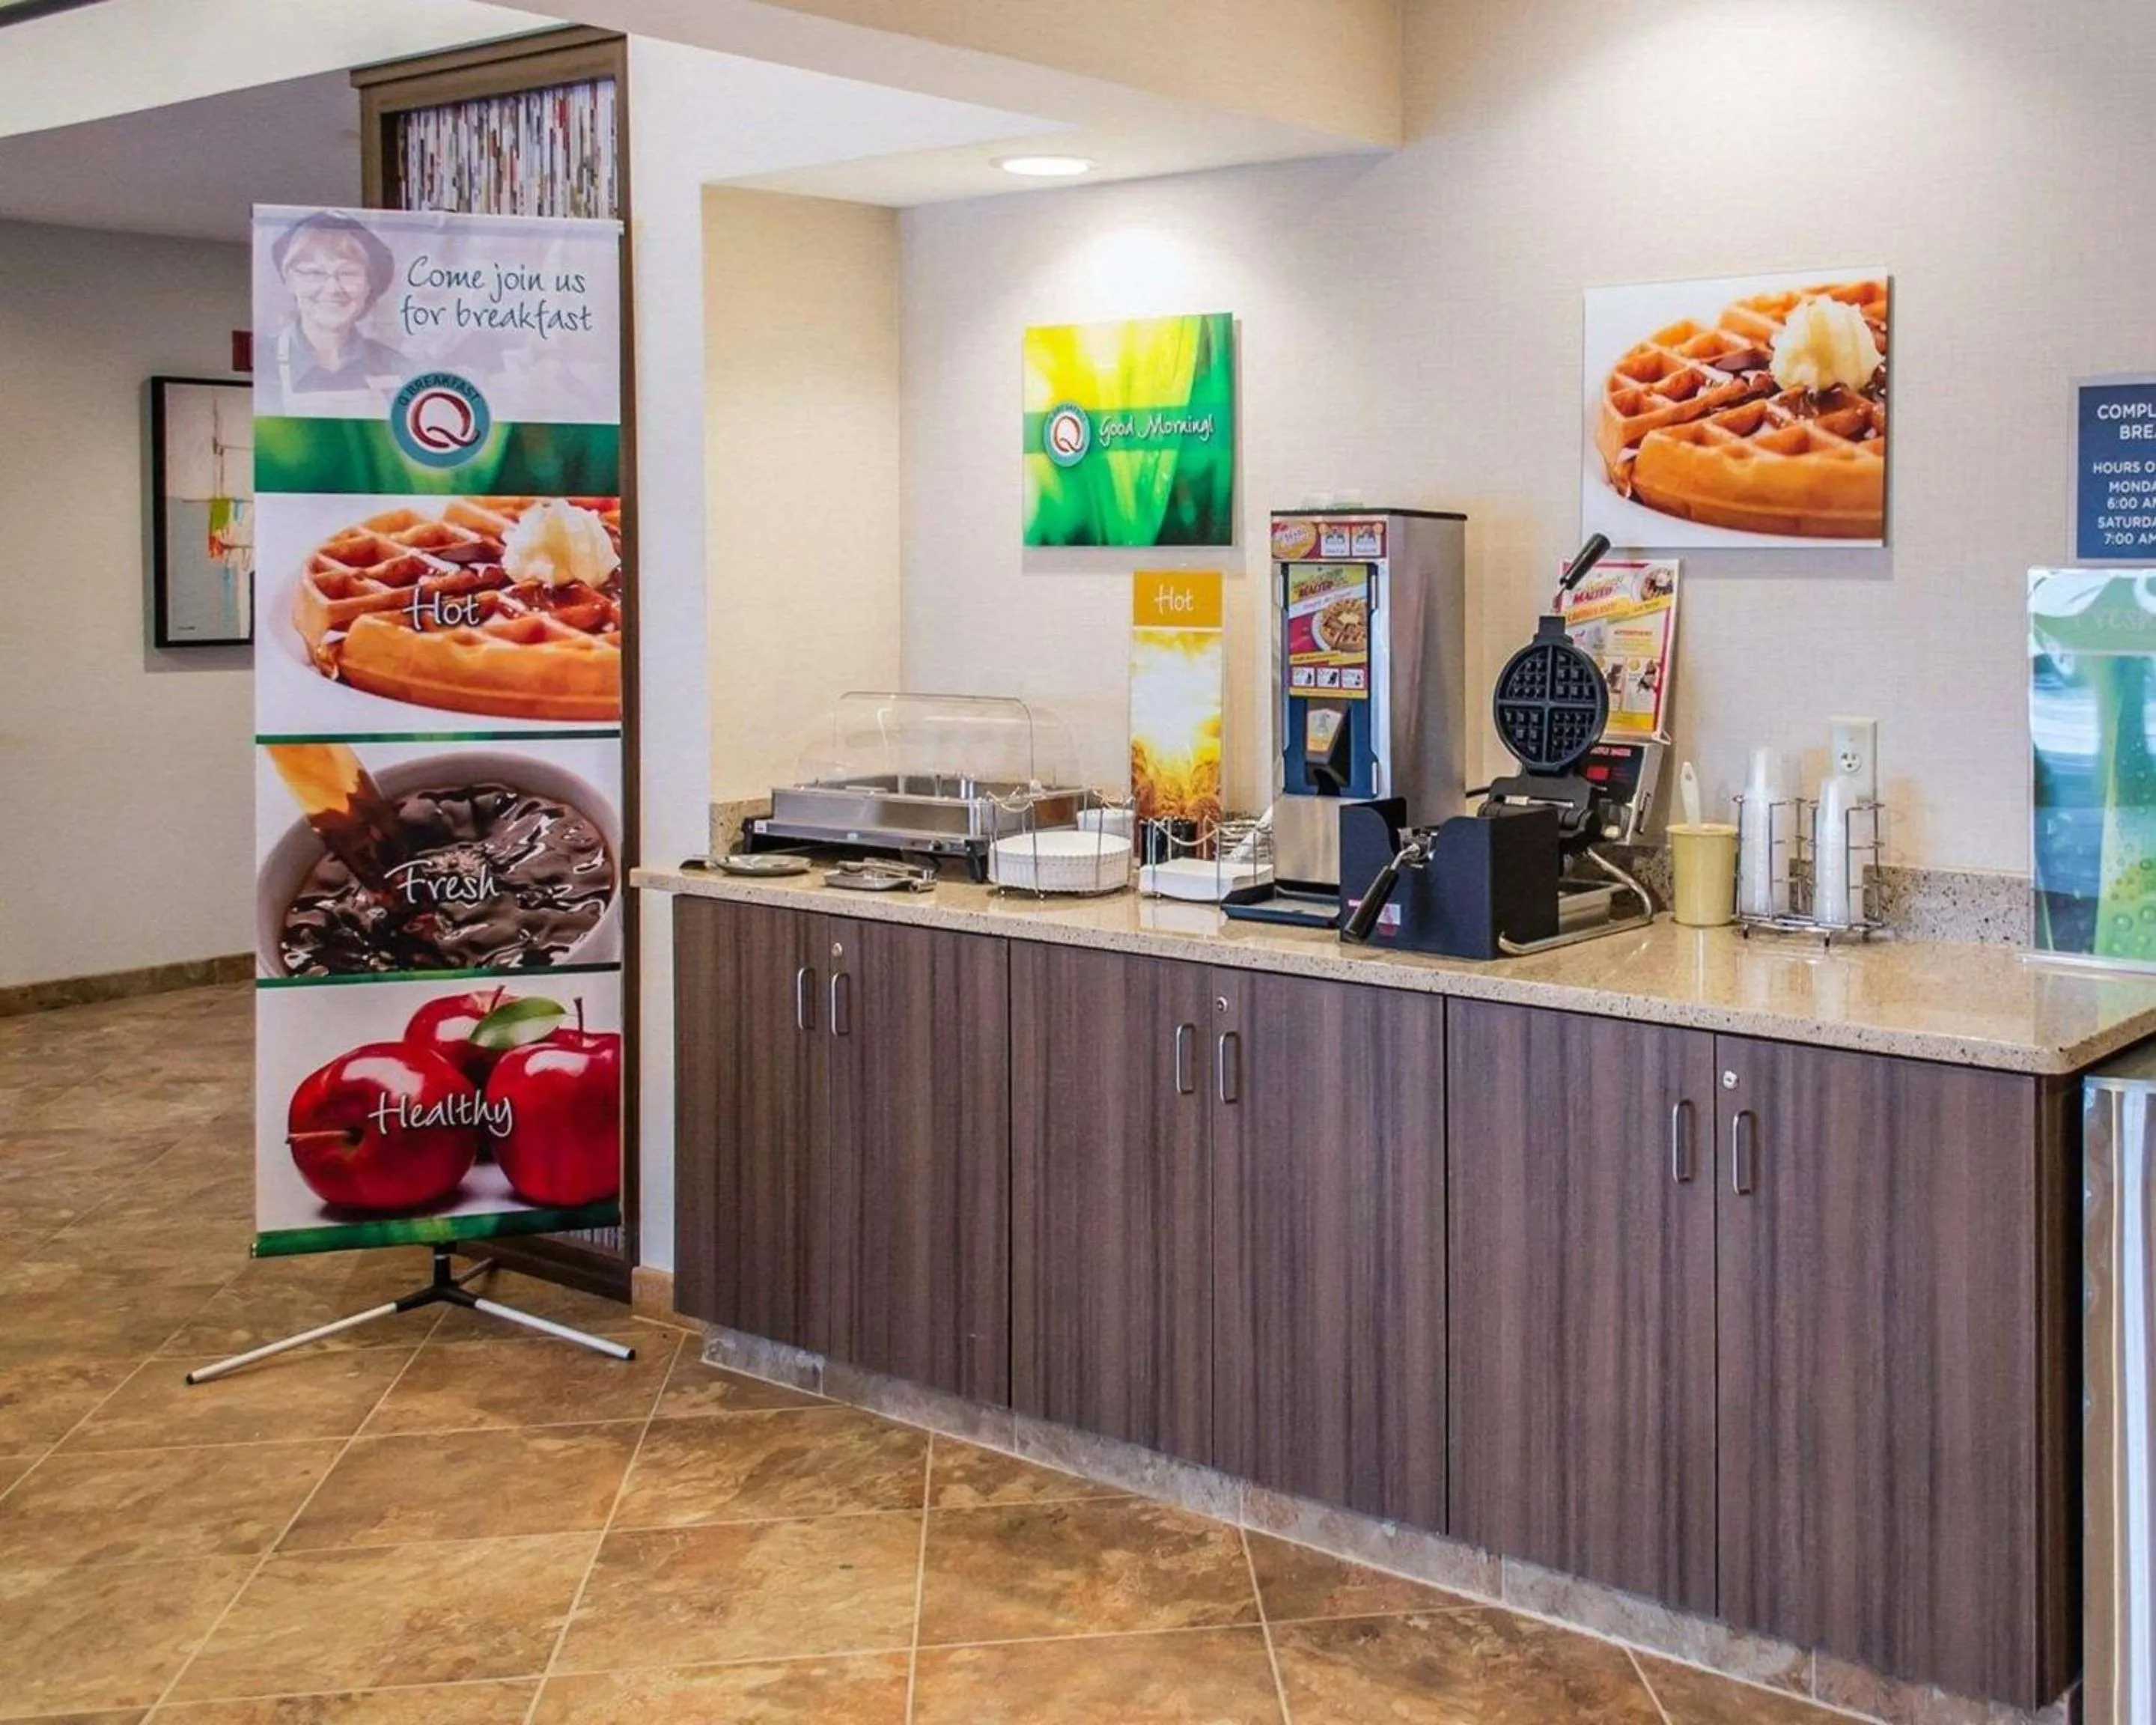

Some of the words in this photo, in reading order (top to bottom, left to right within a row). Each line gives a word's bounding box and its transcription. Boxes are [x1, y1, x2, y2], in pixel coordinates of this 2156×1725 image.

[406, 255, 485, 289] Come
[490, 263, 544, 302] join
[555, 274, 586, 293] us
[399, 294, 447, 335] for
[456, 298, 594, 339] breakfast
[405, 374, 481, 403] BREAKFAST
[409, 392, 481, 448] Q
[2097, 403, 2156, 419] COMPL
[1099, 414, 1134, 447] Good
[1137, 413, 1214, 442] Morning!
[2119, 424, 2156, 440] BRE
[2093, 460, 2141, 474] HOURS
[2107, 496, 2138, 510] 6:00
[402, 586, 481, 630] Hot
[1154, 584, 1194, 615] Hot
[384, 860, 500, 904] Fresh
[367, 1089, 513, 1138] Healthy
